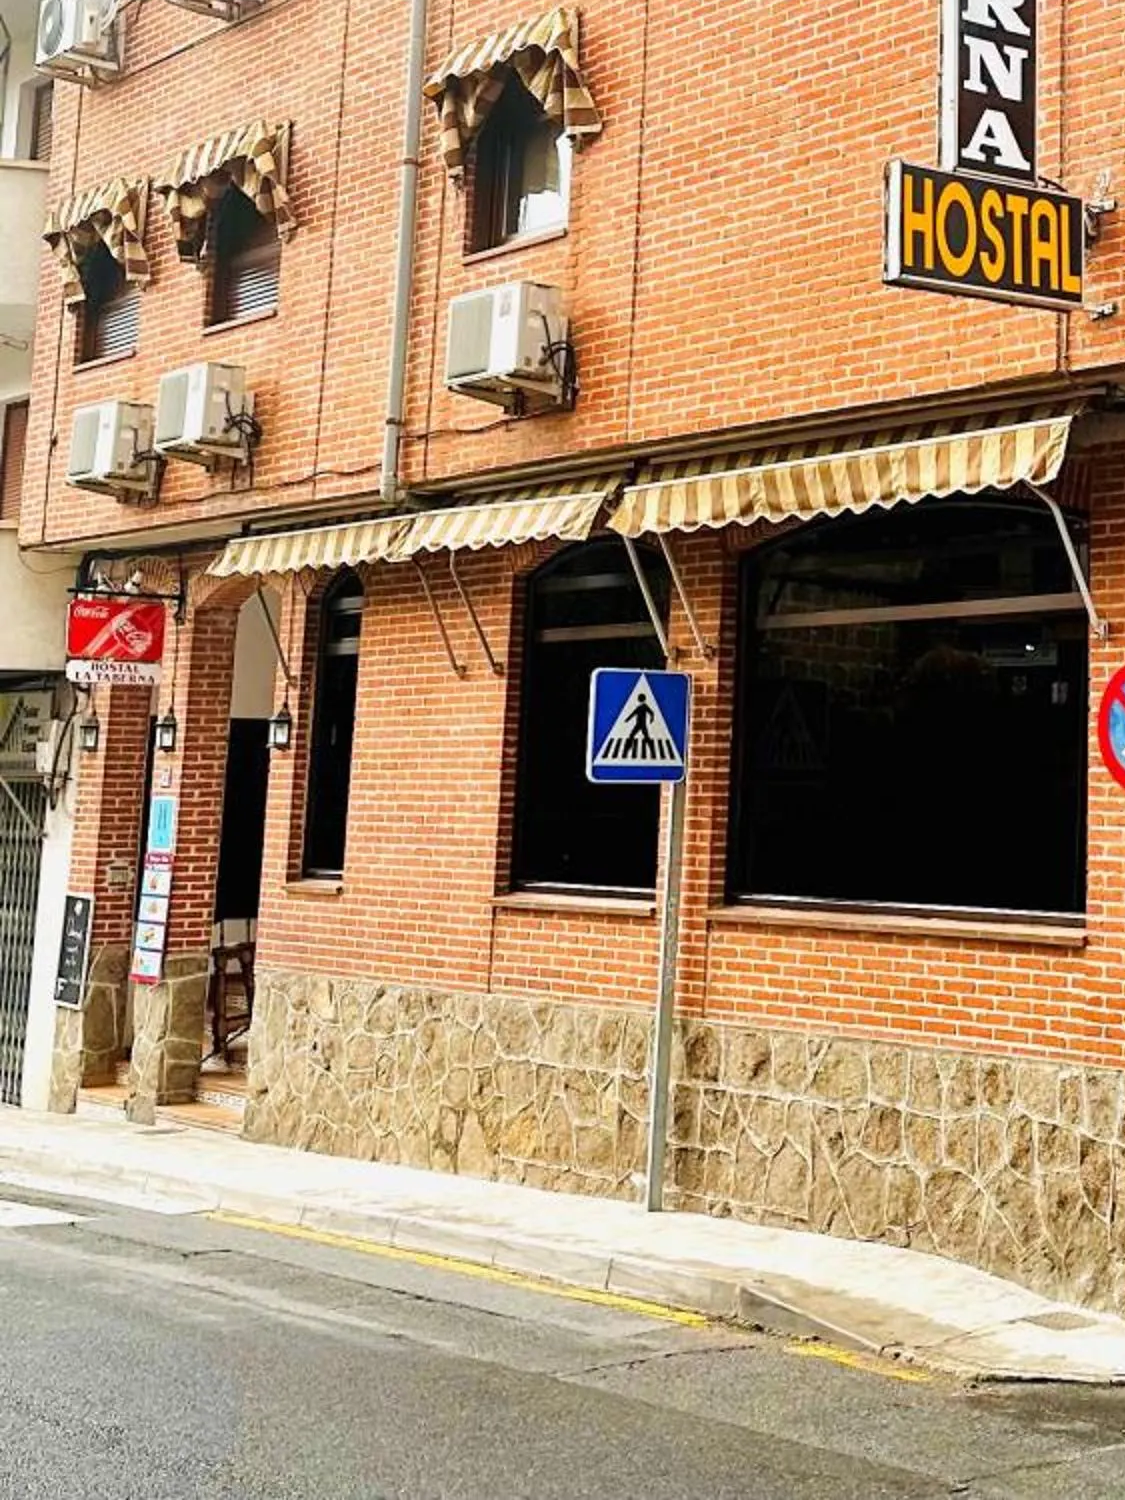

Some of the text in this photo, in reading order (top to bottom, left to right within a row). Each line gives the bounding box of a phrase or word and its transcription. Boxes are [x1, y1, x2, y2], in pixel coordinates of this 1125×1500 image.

[903, 173, 1081, 293] HOSTAL
[91, 662, 140, 673] HOSTAL
[75, 671, 156, 684] LA TABERNA
